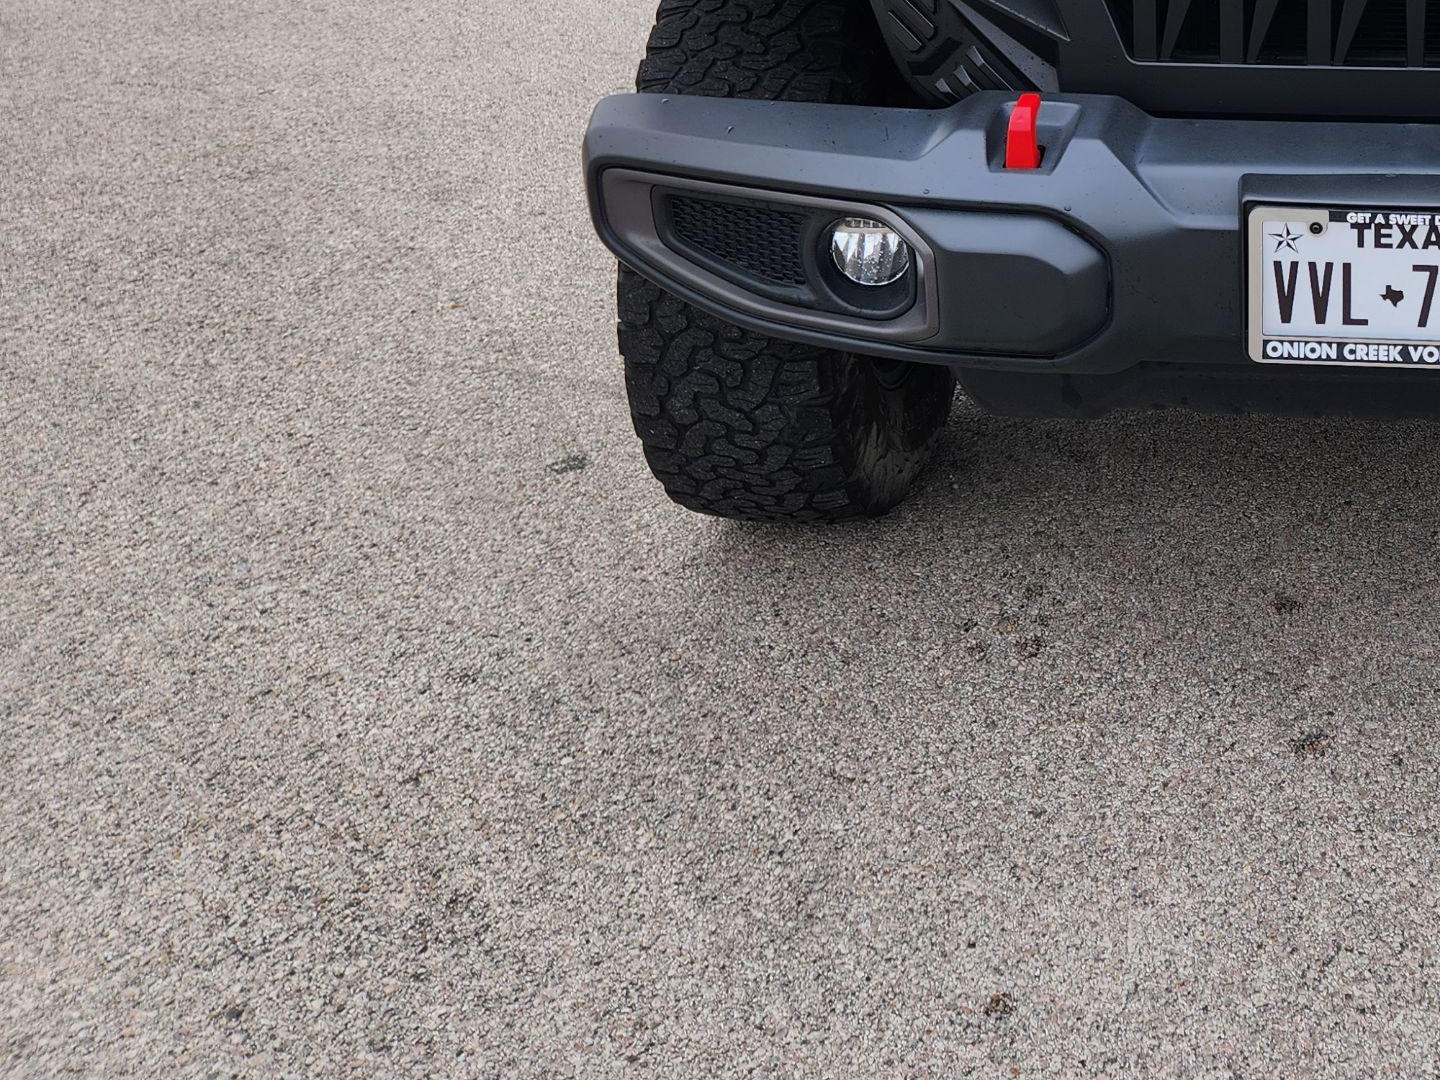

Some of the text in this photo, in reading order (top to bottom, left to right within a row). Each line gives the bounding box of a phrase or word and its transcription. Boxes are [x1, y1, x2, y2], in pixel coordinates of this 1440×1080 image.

[1346, 212, 1372, 224] GET
[1374, 213, 1386, 225] A
[1389, 214, 1431, 226] SWEET
[1273, 260, 1368, 326] VVL
[1266, 341, 1337, 360] ONION
[1343, 343, 1403, 362] CREEK
